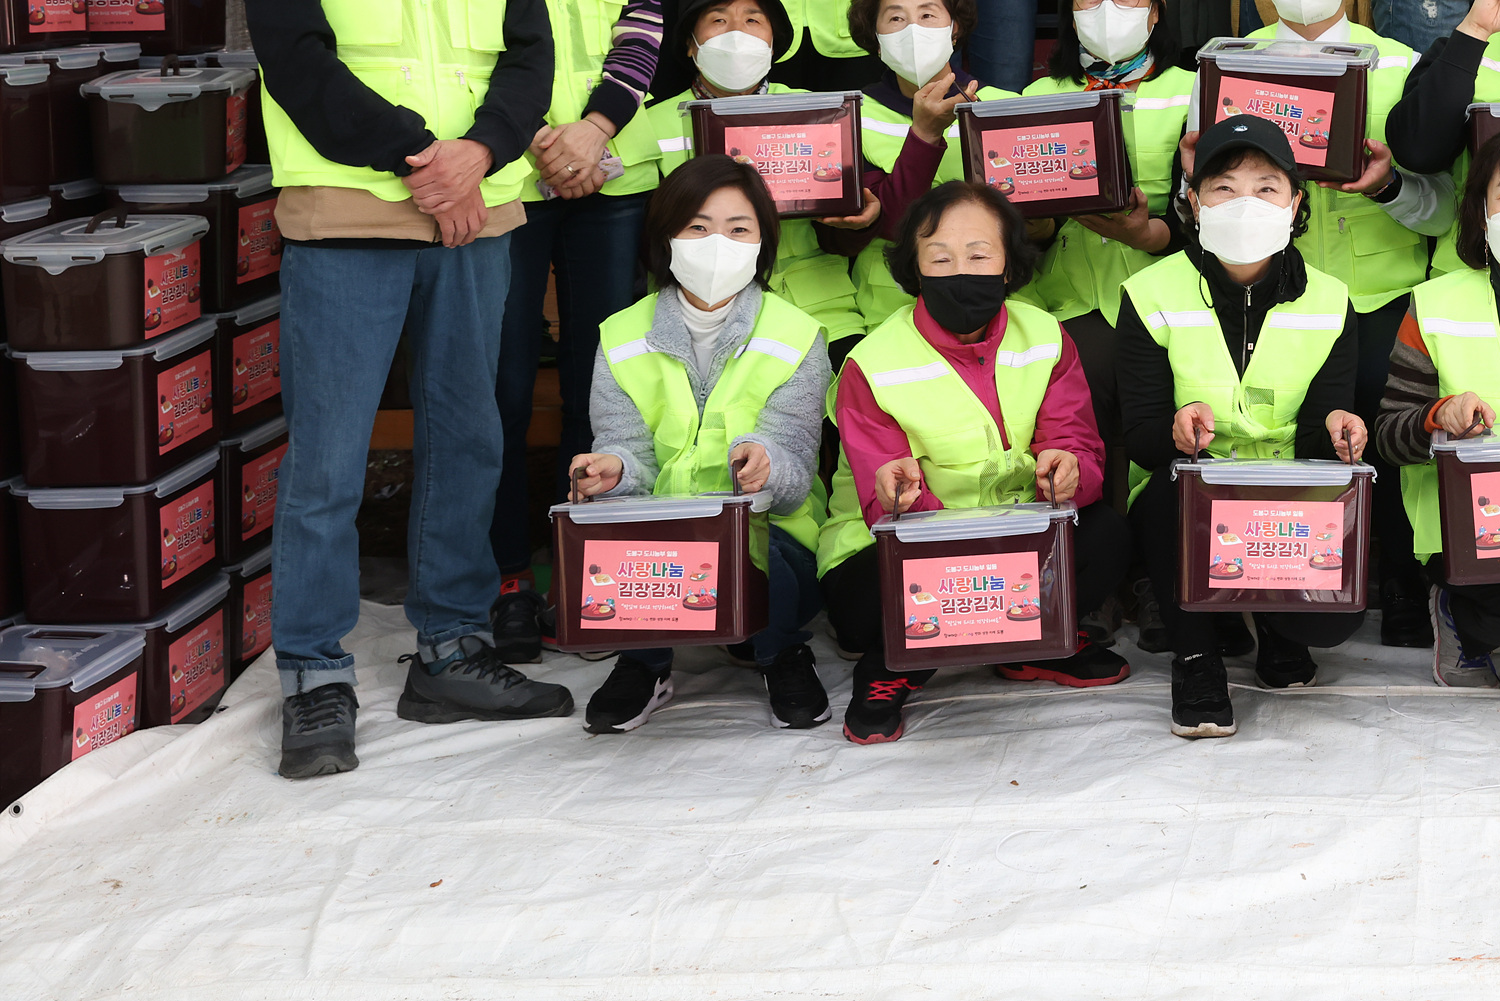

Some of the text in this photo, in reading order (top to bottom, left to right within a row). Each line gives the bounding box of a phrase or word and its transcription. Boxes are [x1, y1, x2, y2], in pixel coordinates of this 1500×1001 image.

[1246, 99, 1303, 119] 사랑나눔
[755, 143, 813, 158] 사랑나눔
[1012, 142, 1067, 159] 사랑나눔
[757, 160, 812, 175] 김장김치
[1014, 159, 1068, 176] 김장김치
[1244, 521, 1310, 538] 사랑나눔
[1246, 541, 1308, 558] 김장김치
[617, 562, 684, 578] 사랑나눔
[618, 582, 681, 598] 김장김치
[938, 576, 1005, 594] 사랑나눔
[941, 595, 1004, 615] 김장김치
[90, 702, 122, 732] 사랑나눔
